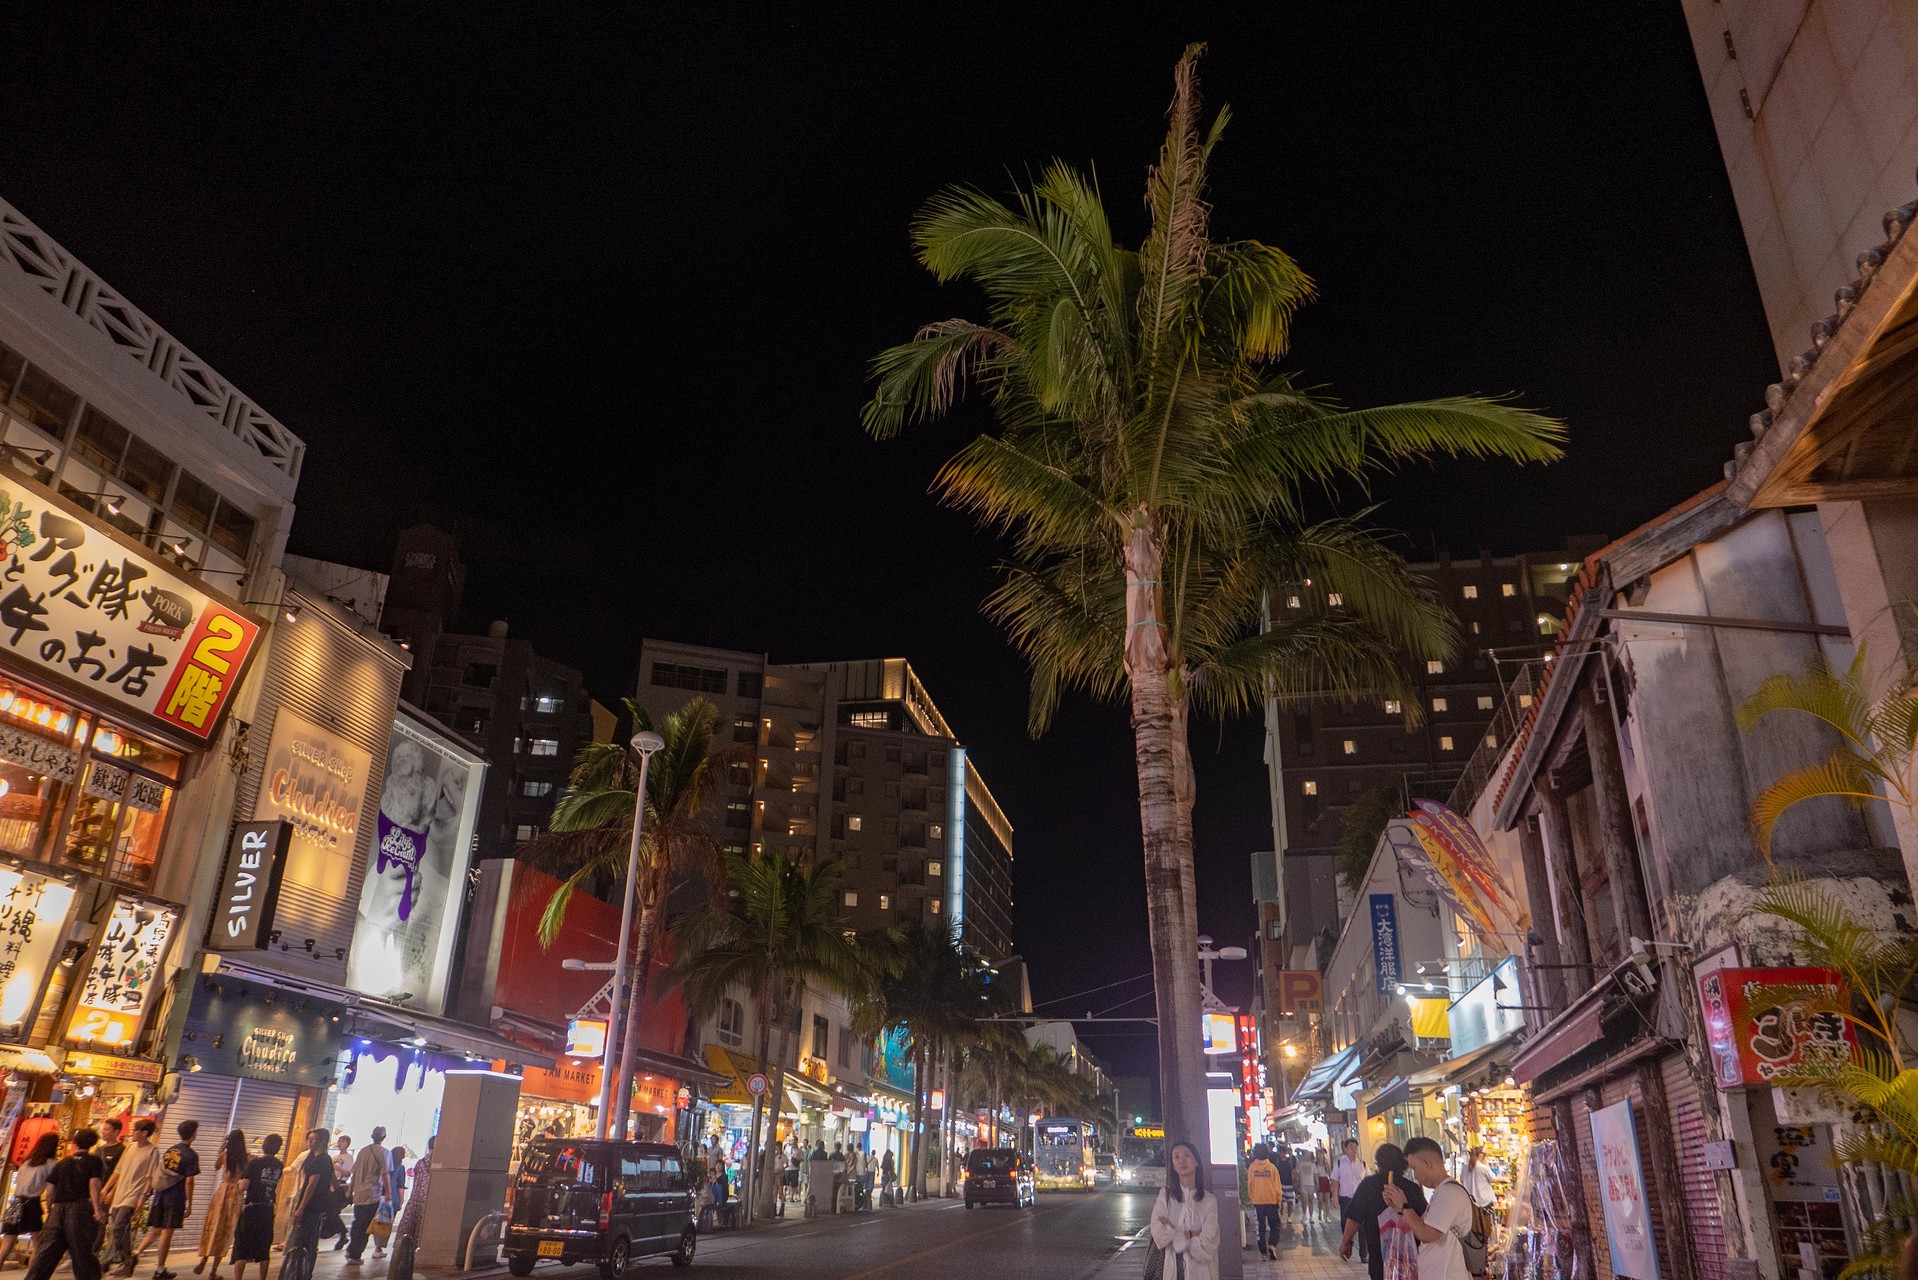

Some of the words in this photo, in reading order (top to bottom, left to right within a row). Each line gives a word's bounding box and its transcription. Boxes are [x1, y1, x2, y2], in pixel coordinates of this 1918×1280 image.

[152, 594, 187, 621] PORK
[144, 623, 163, 633] FRESH
[163, 627, 179, 636] MEAT
[165, 613, 245, 730] 2階
[291, 740, 326, 767] SILVER
[328, 757, 354, 784] SHOP
[271, 768, 357, 832] Cloudica
[389, 827, 413, 850] Lily's
[227, 829, 268, 938] SILVER
[102, 910, 155, 1004] アグー豚
[1284, 973, 1319, 1011] P
[254, 1027, 277, 1037] SILVER
[241, 1034, 298, 1064] Cloudica
[543, 1067, 562, 1080] JAM
[564, 1070, 596, 1086] MARKET
[751, 1079, 764, 1090] 30
[643, 1084, 670, 1100] MARKET
